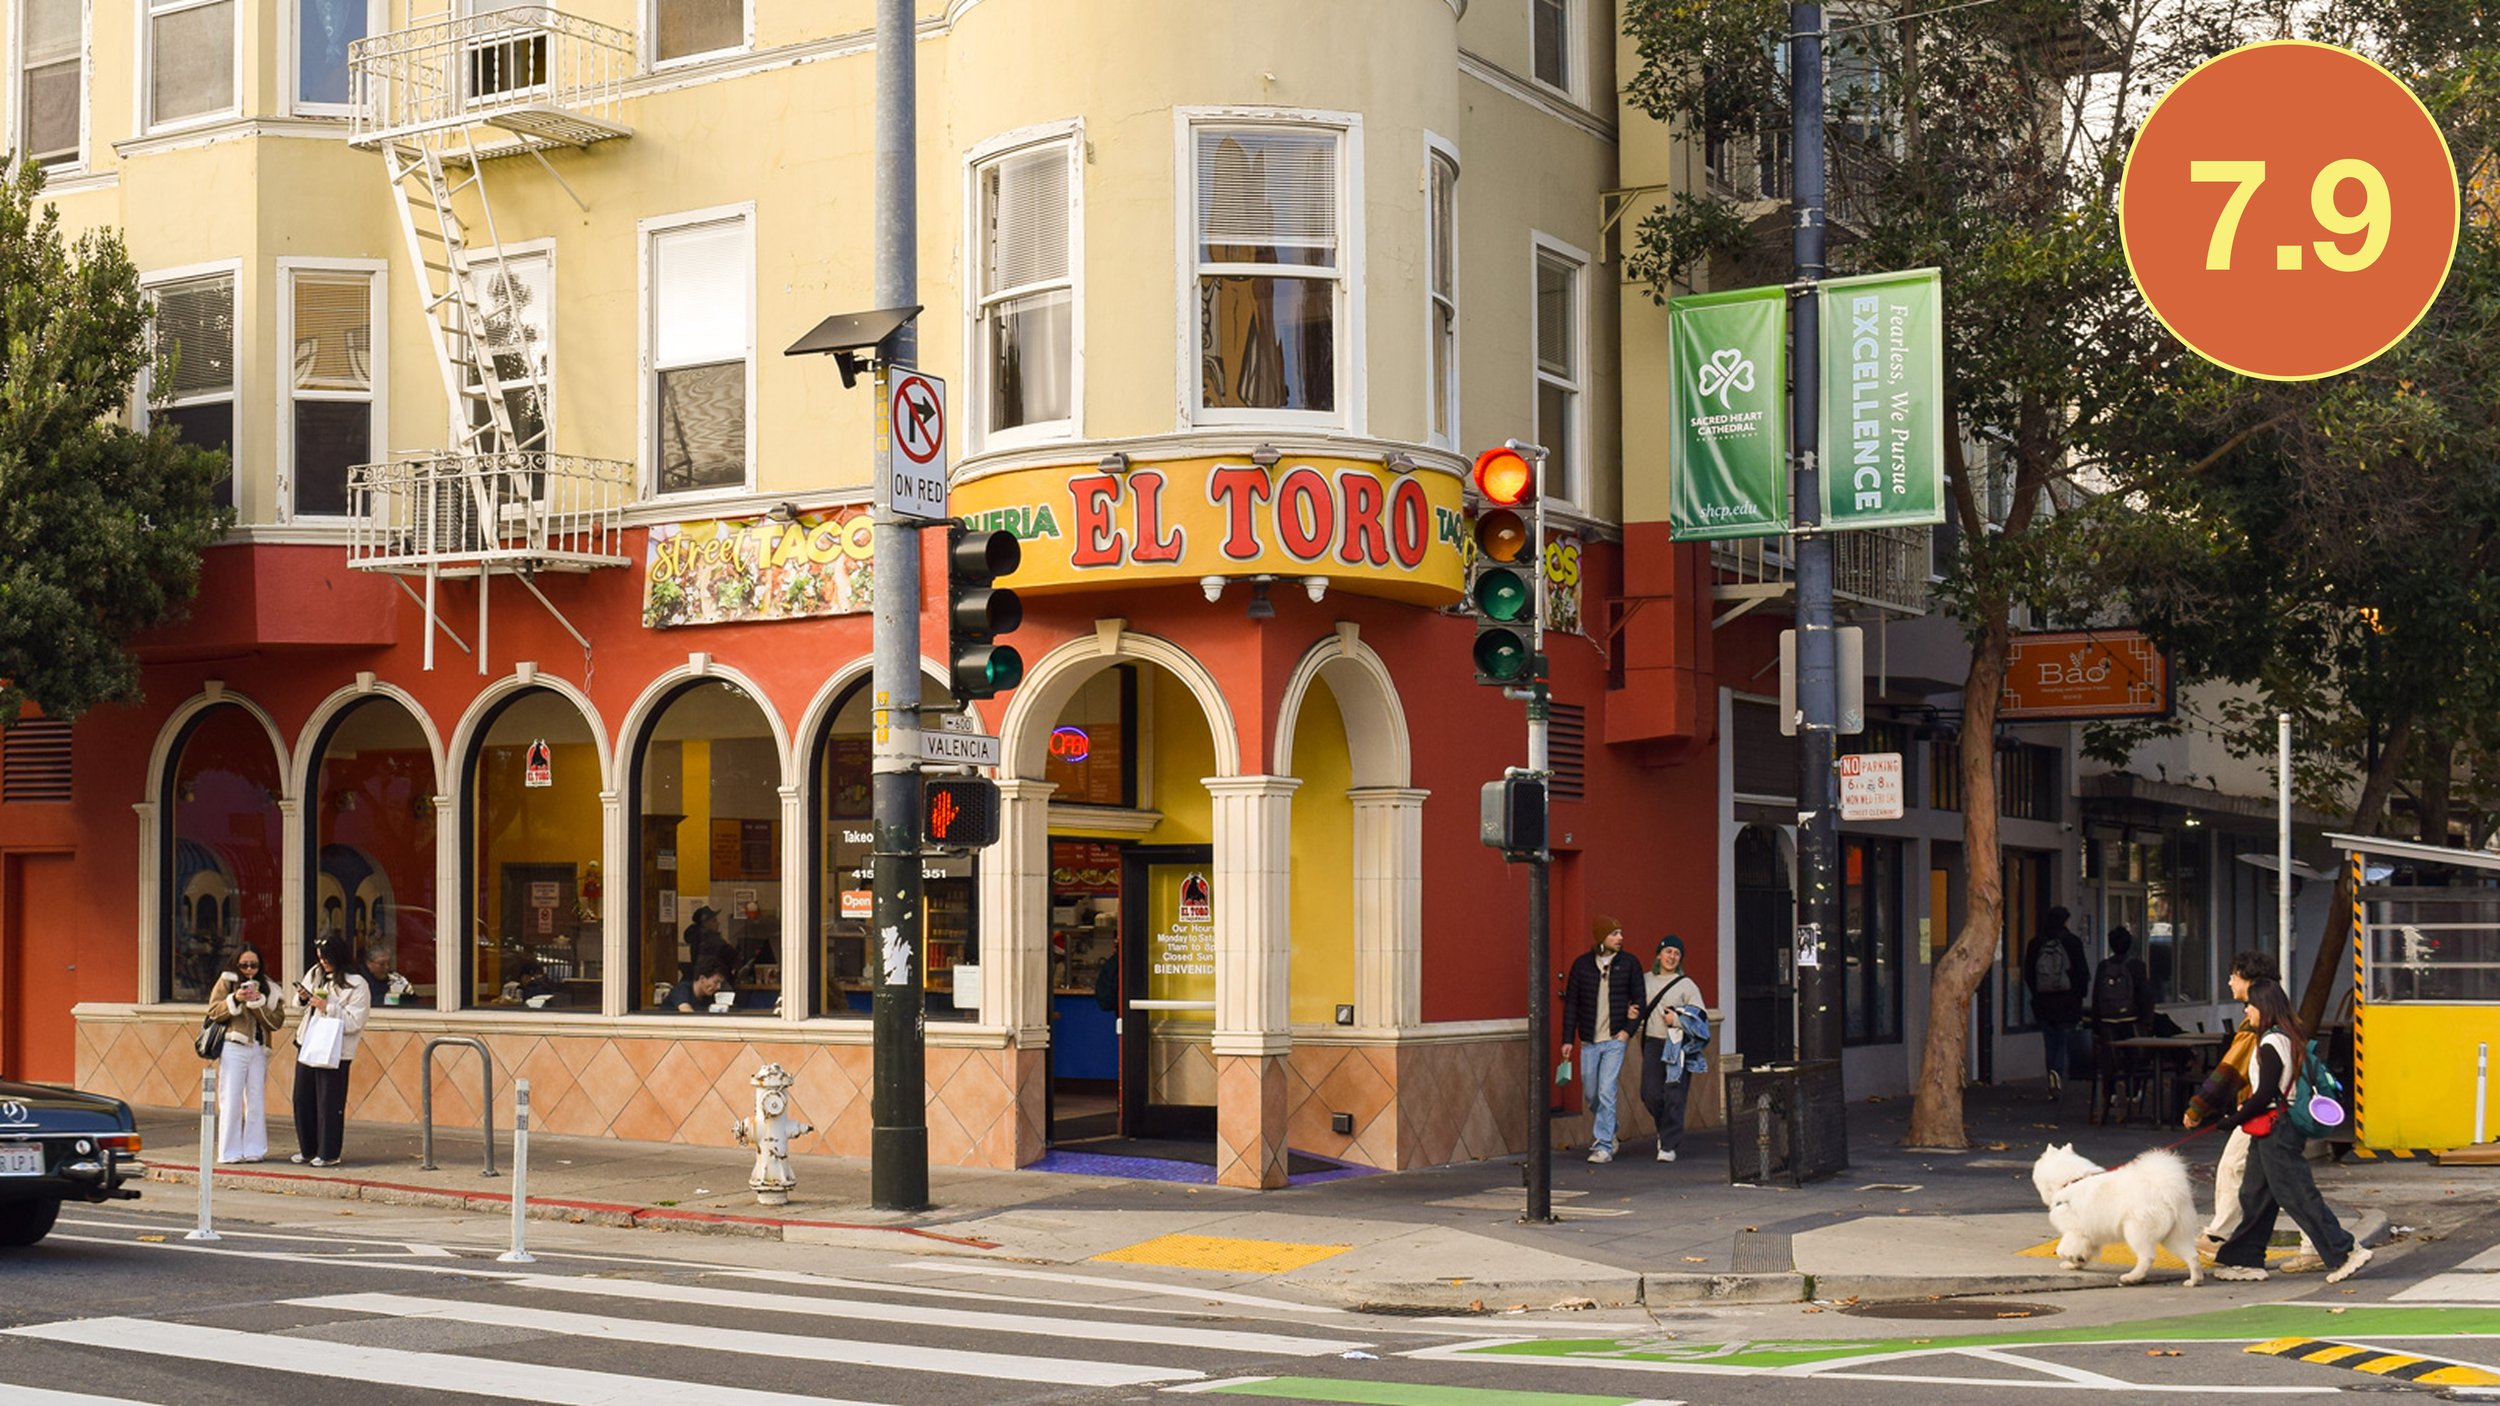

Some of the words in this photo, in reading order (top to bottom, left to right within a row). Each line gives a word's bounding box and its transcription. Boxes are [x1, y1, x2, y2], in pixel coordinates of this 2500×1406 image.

[1887, 303, 1909, 385] Fearless,
[1852, 295, 1882, 511] EXCELLENCE
[1891, 391, 1909, 422] We
[1690, 414, 1728, 427] SACRED
[1730, 411, 1763, 423] HEART
[1697, 422, 1757, 436] CATHEDRAL
[1891, 428, 1910, 494] Pursue
[894, 473, 914, 498] ON
[917, 478, 944, 504] RED
[1067, 471, 1184, 568] EL
[1210, 466, 1429, 568] TORO
[1699, 500, 1758, 520] shcp.edu
[1543, 542, 1579, 587] OS
[927, 737, 990, 759] VALENCIA
[1049, 732, 1088, 755] OPEN
[1843, 756, 1860, 775] NO
[1862, 760, 1899, 773] PARKING
[851, 869, 875, 879] 415
[922, 869, 947, 879] 351
[843, 894, 871, 909] Open
[1181, 906, 1189, 916] EL
[1172, 924, 1187, 933] Our
[1157, 934, 1187, 943] Monday
[1189, 934, 1197, 942] to
[1168, 943, 1188, 951] 11am
[1191, 943, 1200, 951] to
[1163, 952, 1193, 961] Closed
[1196, 953, 1213, 961] Sun
